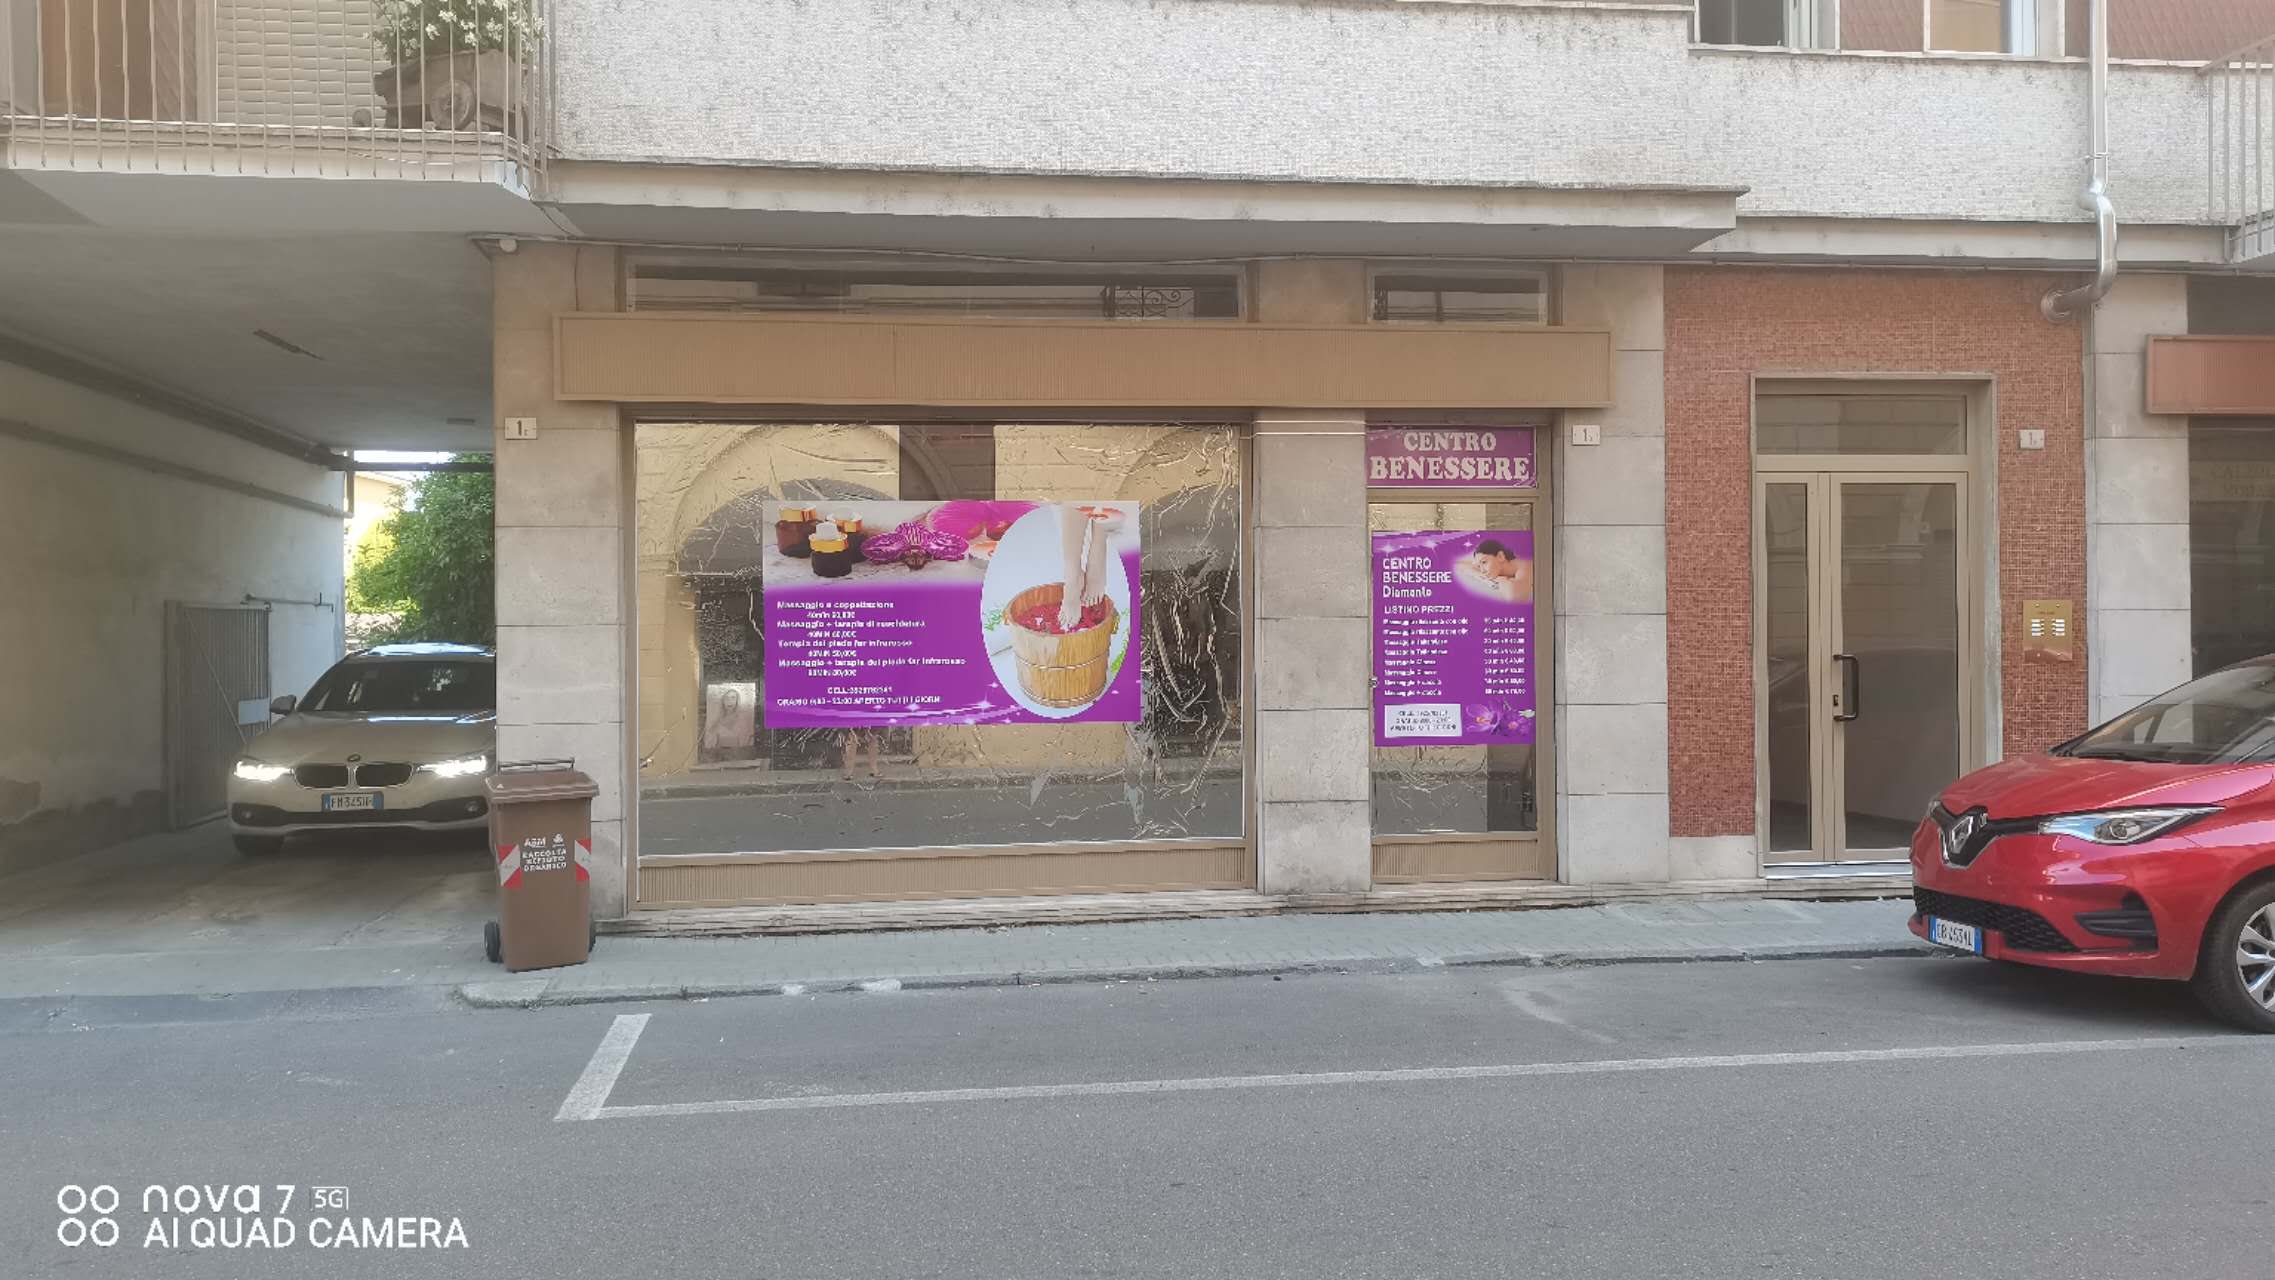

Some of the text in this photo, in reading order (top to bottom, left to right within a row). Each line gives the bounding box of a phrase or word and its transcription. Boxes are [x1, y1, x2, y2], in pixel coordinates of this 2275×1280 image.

[1403, 432, 1497, 451] CENTRO
[1369, 456, 1530, 481] BENESSERE
[1382, 557, 1432, 570] CENTRO
[1382, 571, 1453, 583] BENESSERE
[1383, 605, 1420, 615] LISTINO
